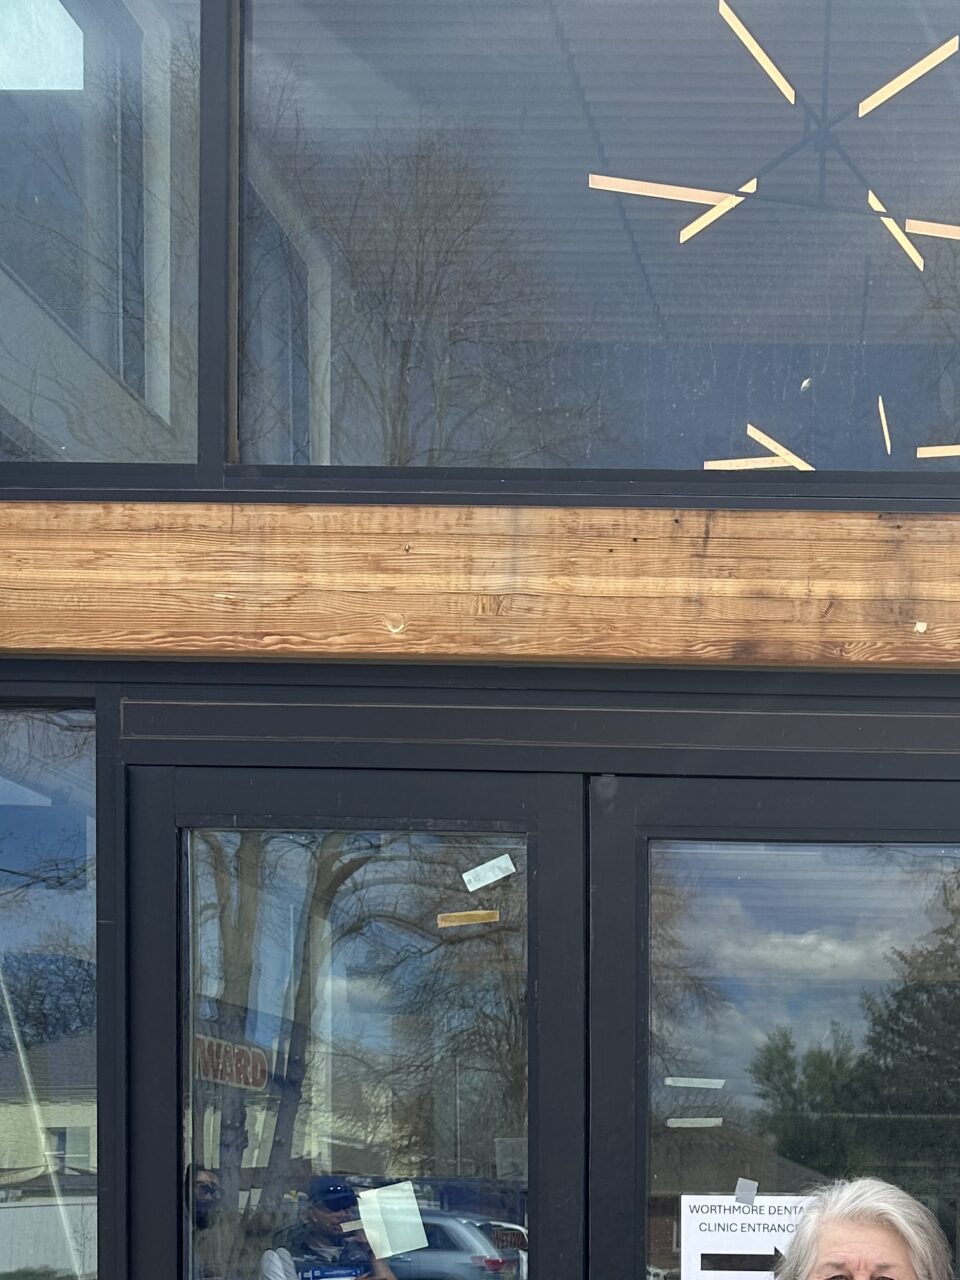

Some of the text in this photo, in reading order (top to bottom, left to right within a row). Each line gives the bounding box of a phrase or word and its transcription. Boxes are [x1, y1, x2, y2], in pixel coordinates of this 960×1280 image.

[688, 1204, 805, 1215] WORTHMORE DENTA
[698, 1222, 738, 1233] CLINIC
